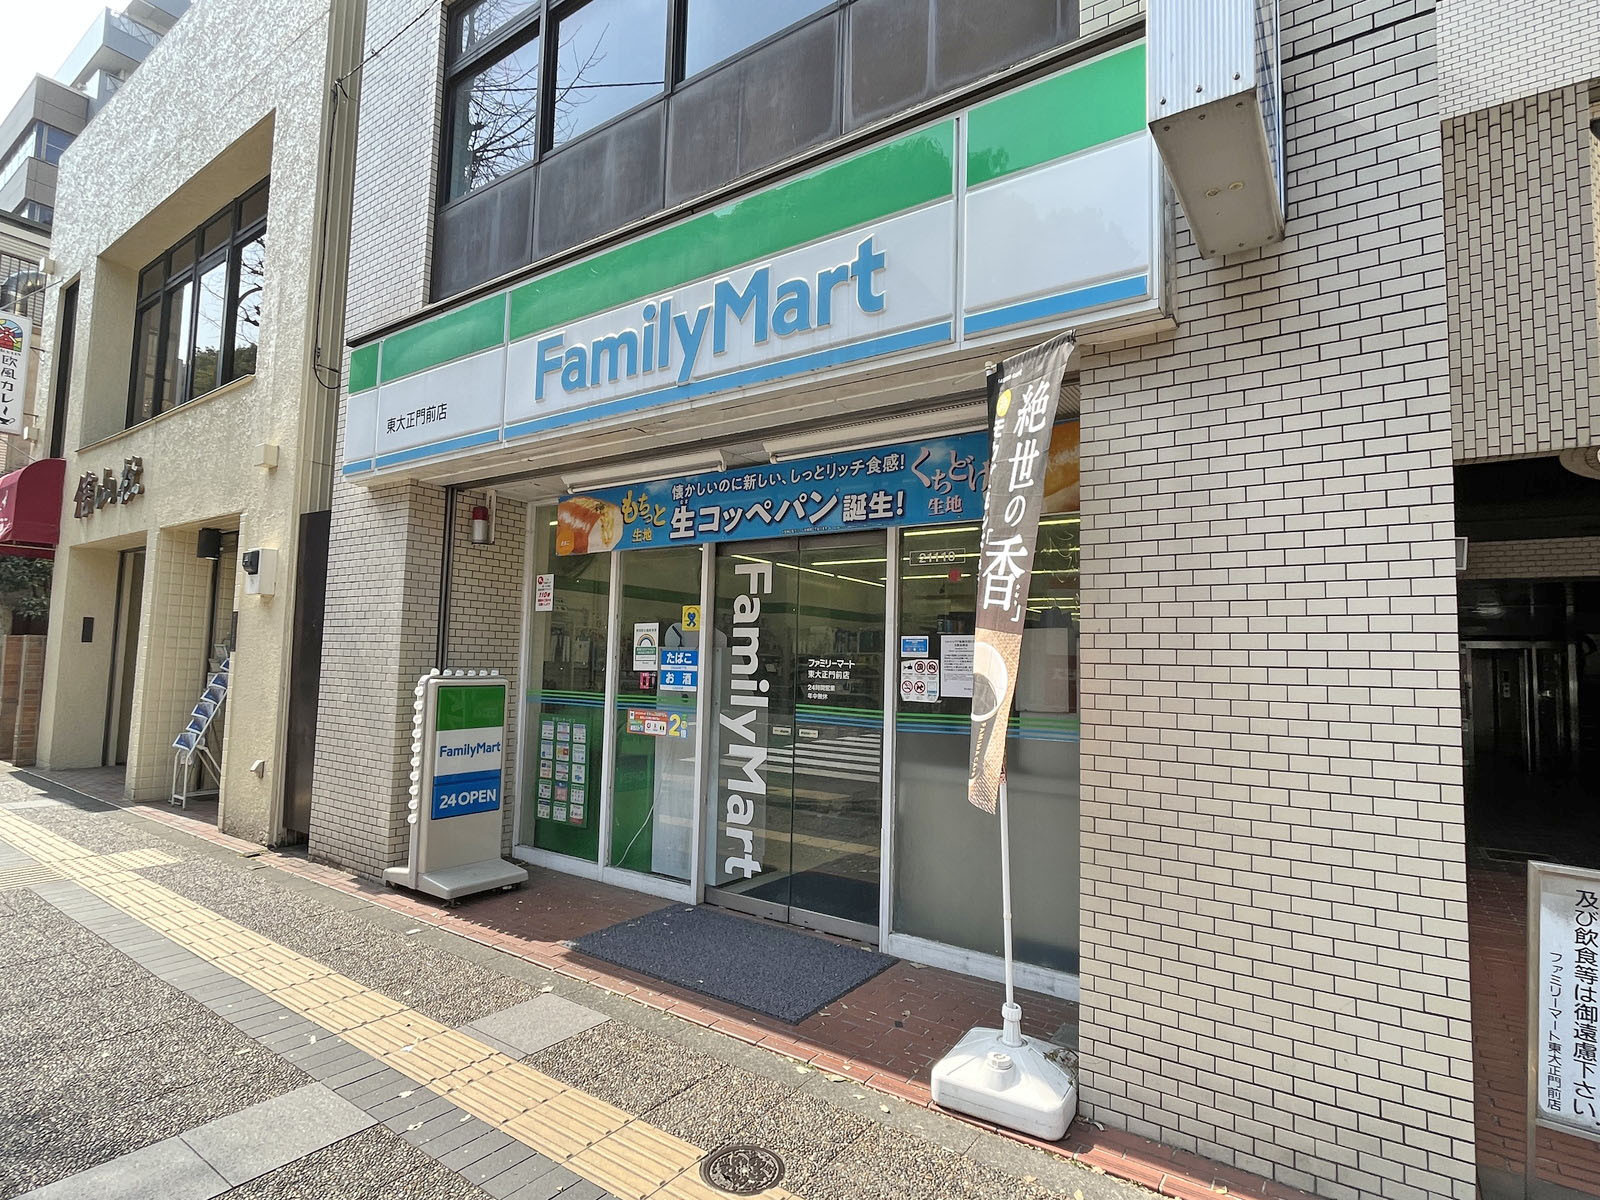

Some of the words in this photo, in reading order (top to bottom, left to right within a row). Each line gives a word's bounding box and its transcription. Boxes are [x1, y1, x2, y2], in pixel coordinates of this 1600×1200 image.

[535, 234, 888, 402] FamilyMart
[1, 354, 18, 416] 欧風カレー
[387, 403, 447, 434] 東大正門前店
[621, 490, 666, 527] もちっと
[928, 496, 963, 516] 生地
[631, 528, 653, 542] 生地
[667, 652, 692, 664] たばこ
[808, 659, 856, 669] ファミリーマート
[665, 672, 692, 685] お酒
[808, 670, 850, 679] 東大正門前店
[720, 563, 773, 878] FamilyMart
[440, 741, 501, 758] FamilyMart
